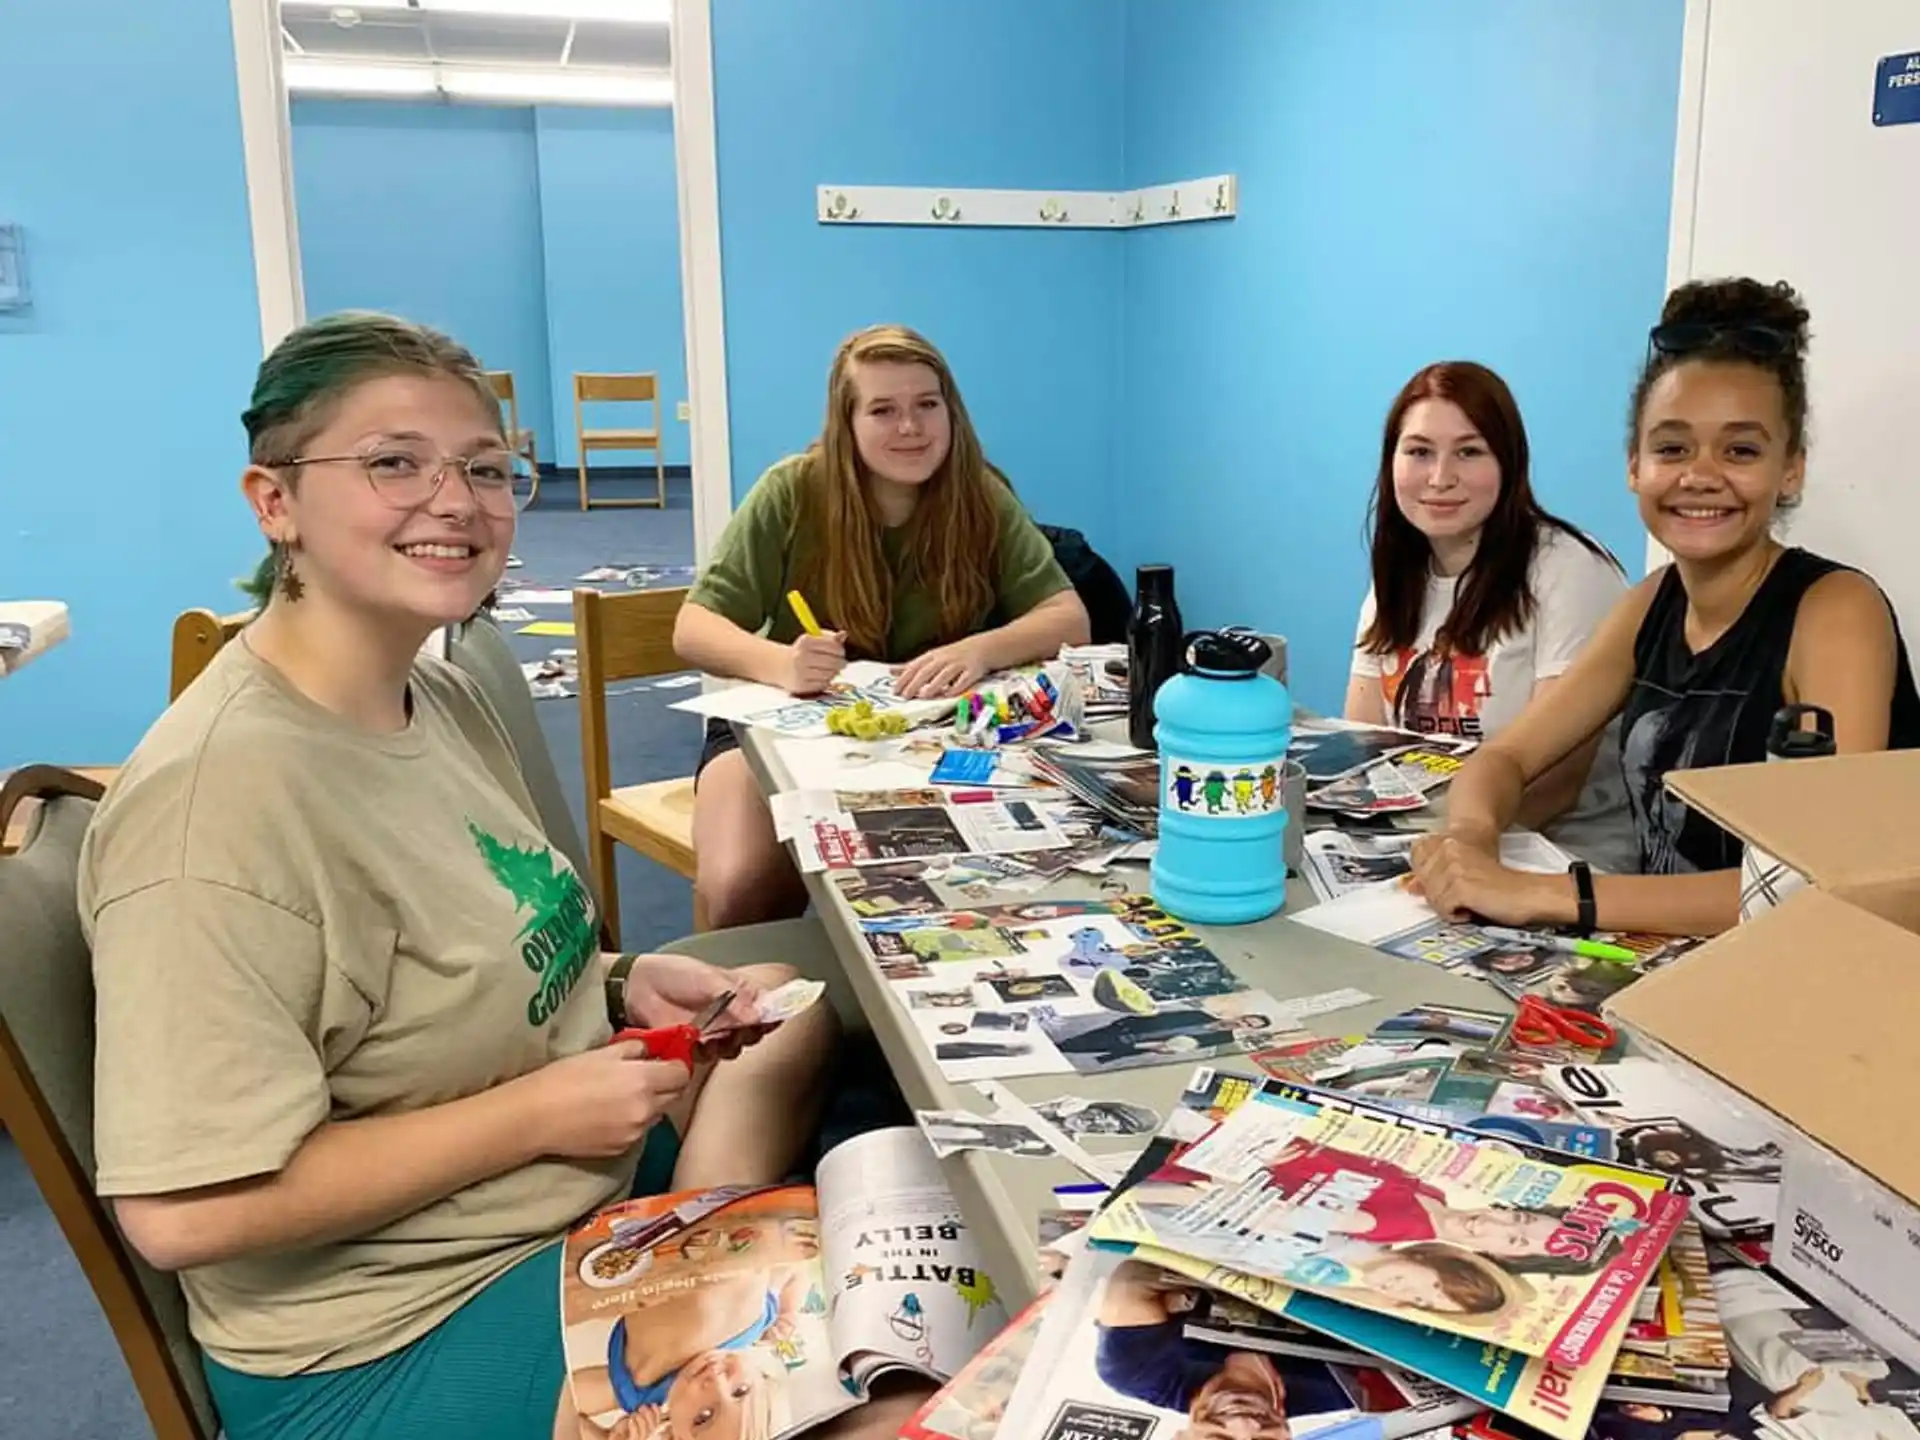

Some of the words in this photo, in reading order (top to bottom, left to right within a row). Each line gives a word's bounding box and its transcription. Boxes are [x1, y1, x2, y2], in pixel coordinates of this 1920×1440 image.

[855, 1225, 958, 1249] BELLY
[1794, 1214, 1843, 1262] Sysco
[883, 1247, 913, 1258] THE
[919, 1247, 938, 1257] IN
[844, 1264, 976, 1290] BATTLE
